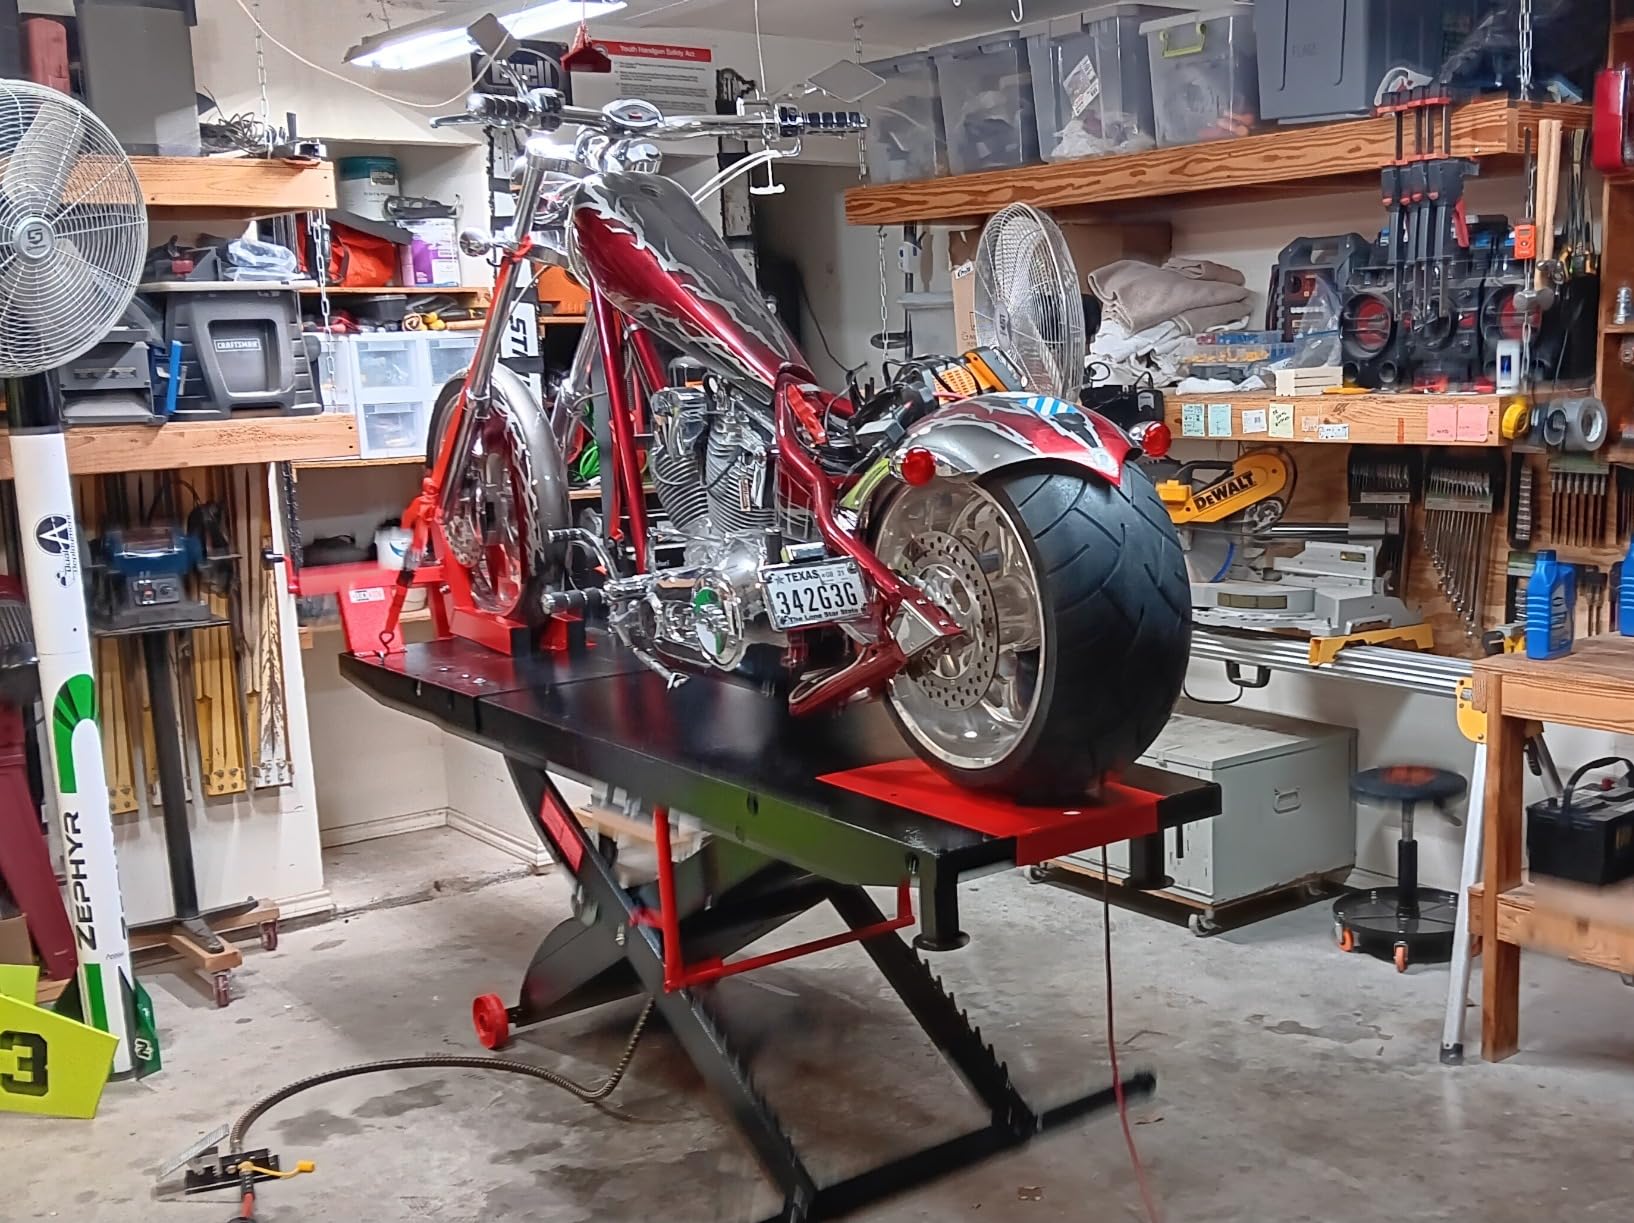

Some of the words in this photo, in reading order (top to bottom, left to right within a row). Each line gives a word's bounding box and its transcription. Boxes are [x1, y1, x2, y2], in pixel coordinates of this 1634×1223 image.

[217, 340, 258, 349] CRAFTSMAN
[784, 569, 820, 583] TEXAS
[776, 582, 858, 615] 342G3G
[64, 811, 97, 950] ZEPHYR
